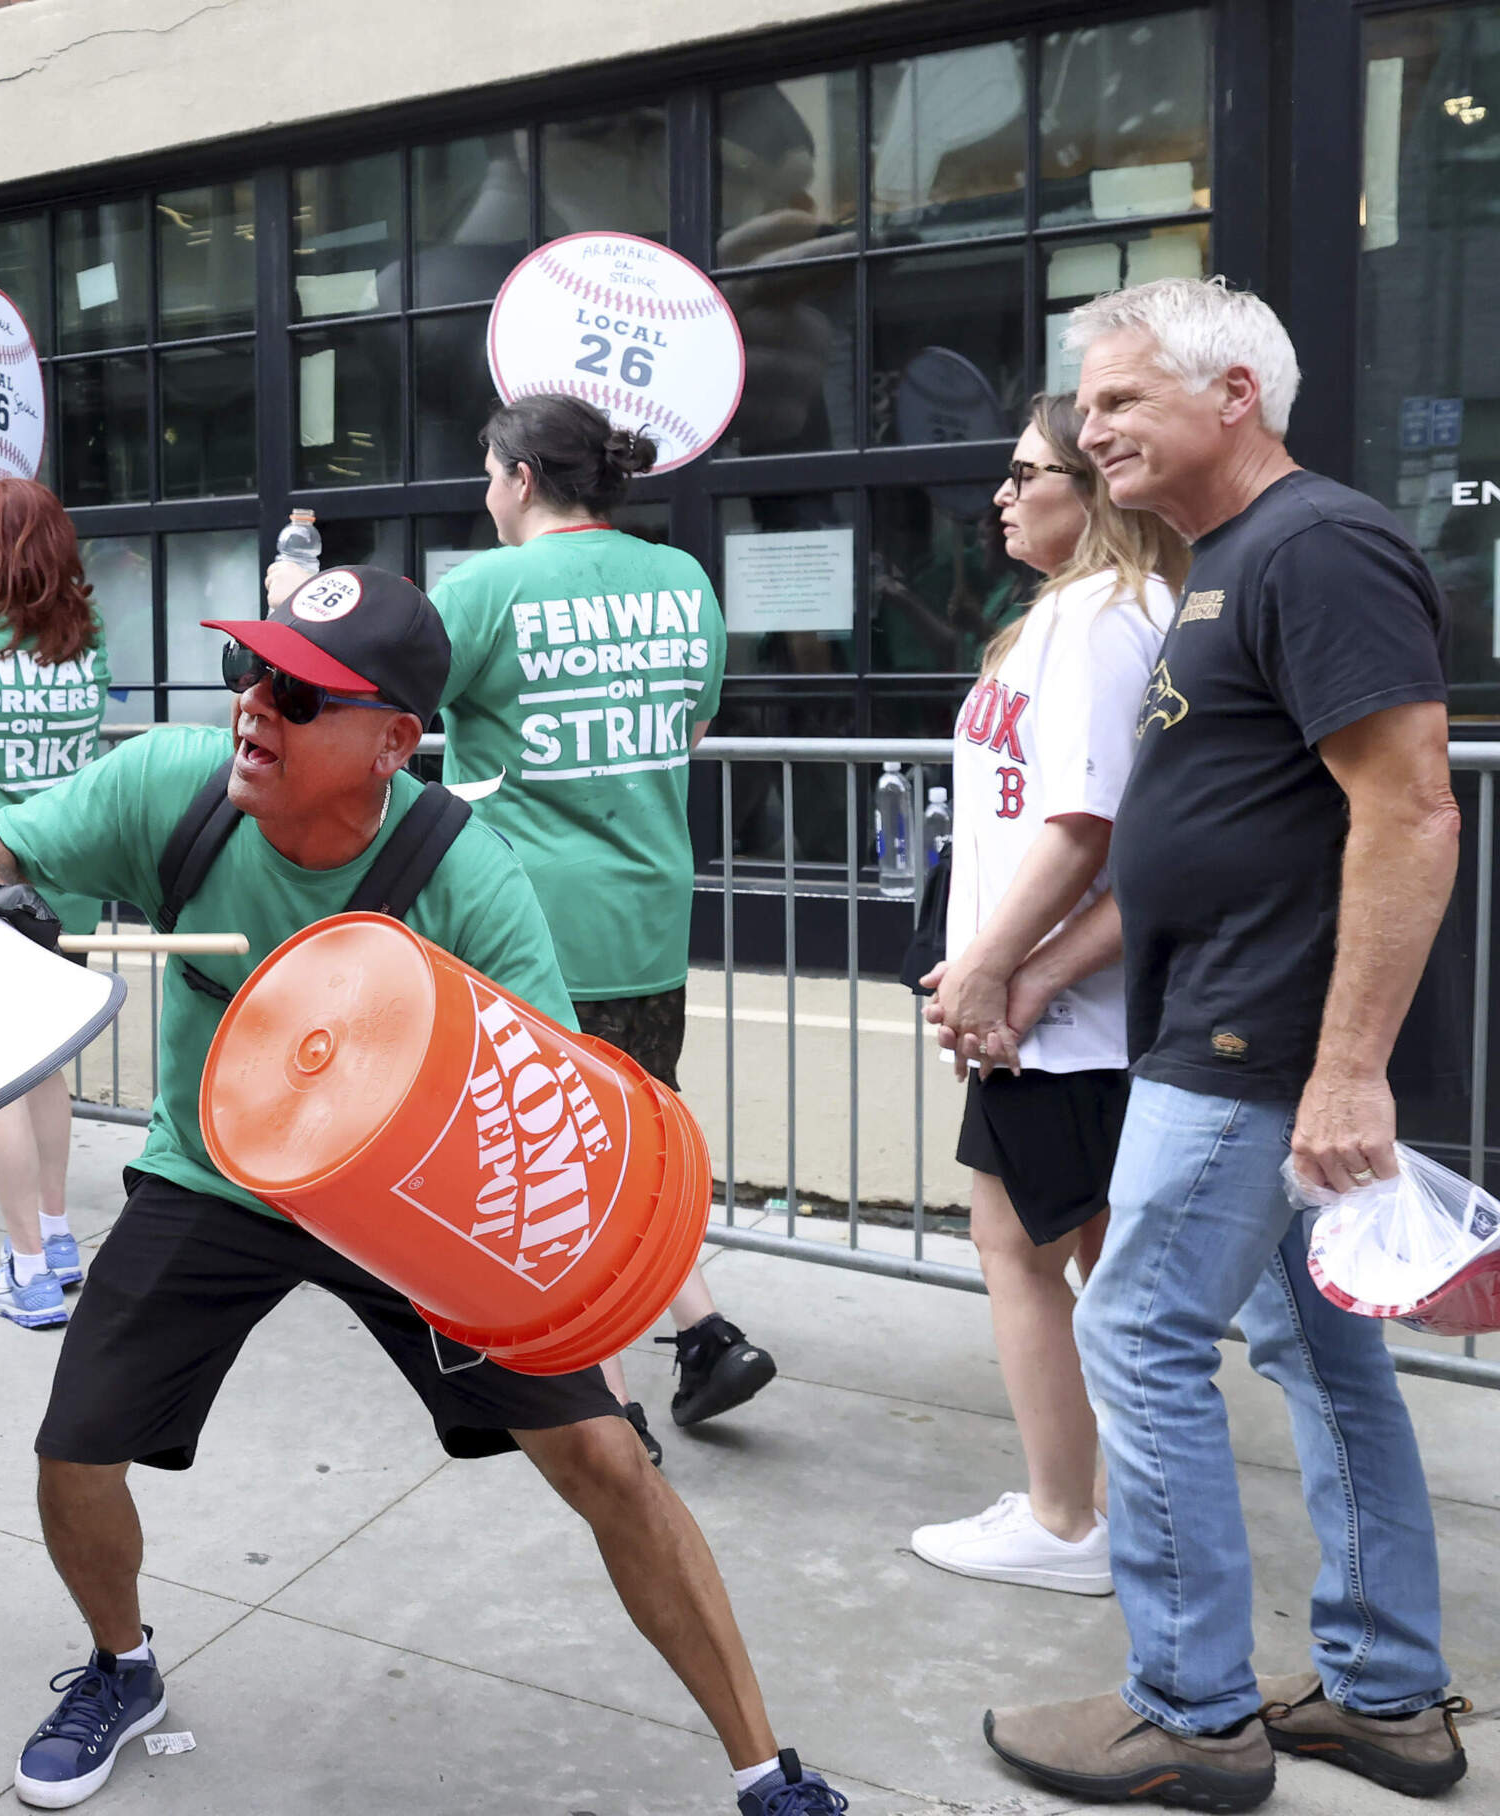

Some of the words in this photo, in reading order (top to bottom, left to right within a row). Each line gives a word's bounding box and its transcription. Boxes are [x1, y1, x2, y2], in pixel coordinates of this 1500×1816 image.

[575, 307, 669, 348] LOCAL
[574, 333, 656, 388] 26
[307, 586, 344, 608] 26
[511, 589, 702, 649] FENWAY
[517, 638, 709, 682] WORKERS
[607, 678, 644, 700] ON
[10, 718, 44, 735] ON
[995, 766, 1027, 819] B
[554, 1051, 613, 1163] THE
[468, 1064, 519, 1239] DEPOT
[478, 997, 592, 1272] HOME
